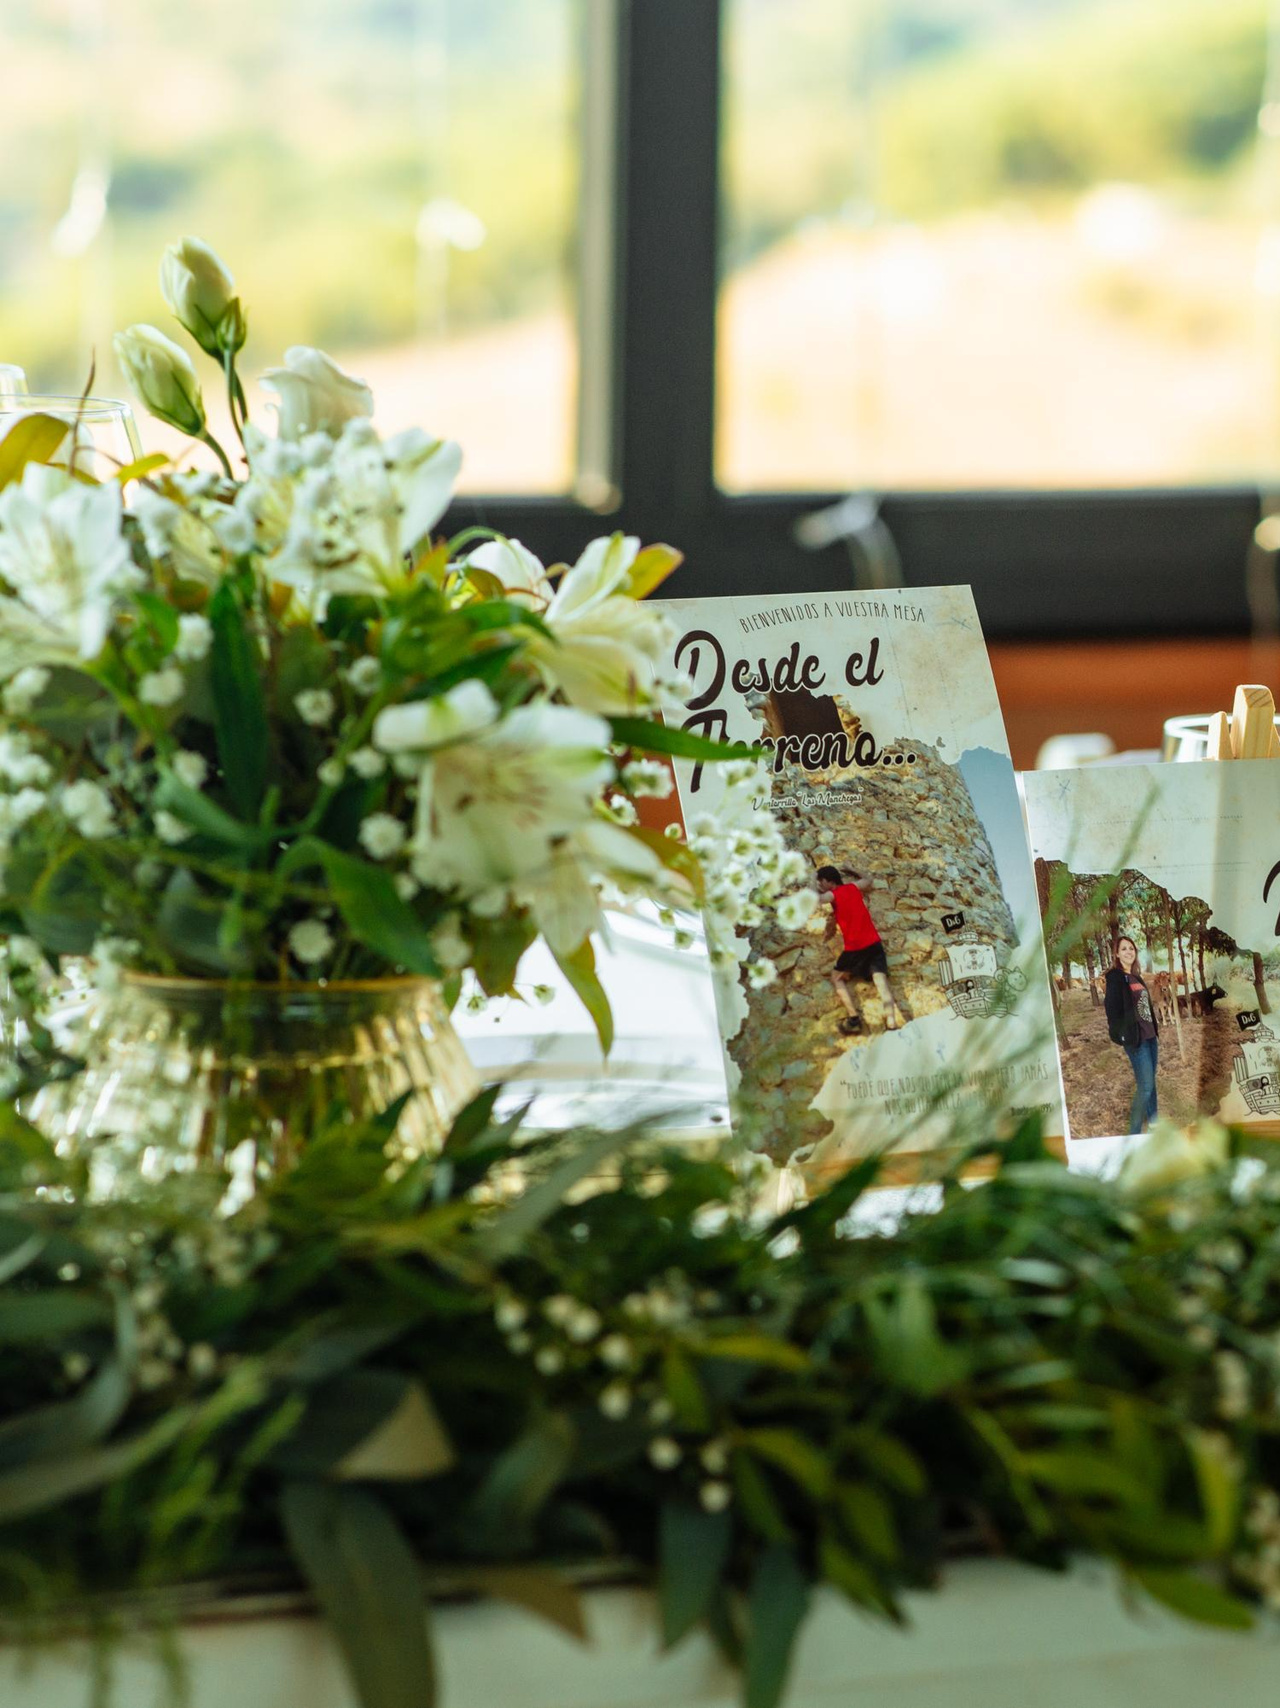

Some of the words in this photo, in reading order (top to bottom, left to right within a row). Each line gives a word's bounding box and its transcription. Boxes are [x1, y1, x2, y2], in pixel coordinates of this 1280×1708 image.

[739, 603, 819, 634] BIENVENIDOS
[824, 602, 833, 617] A
[835, 601, 889, 618] VUESTRA
[893, 604, 926, 623] MESA
[674, 630, 827, 711] Desde
[845, 636, 885, 687] el
